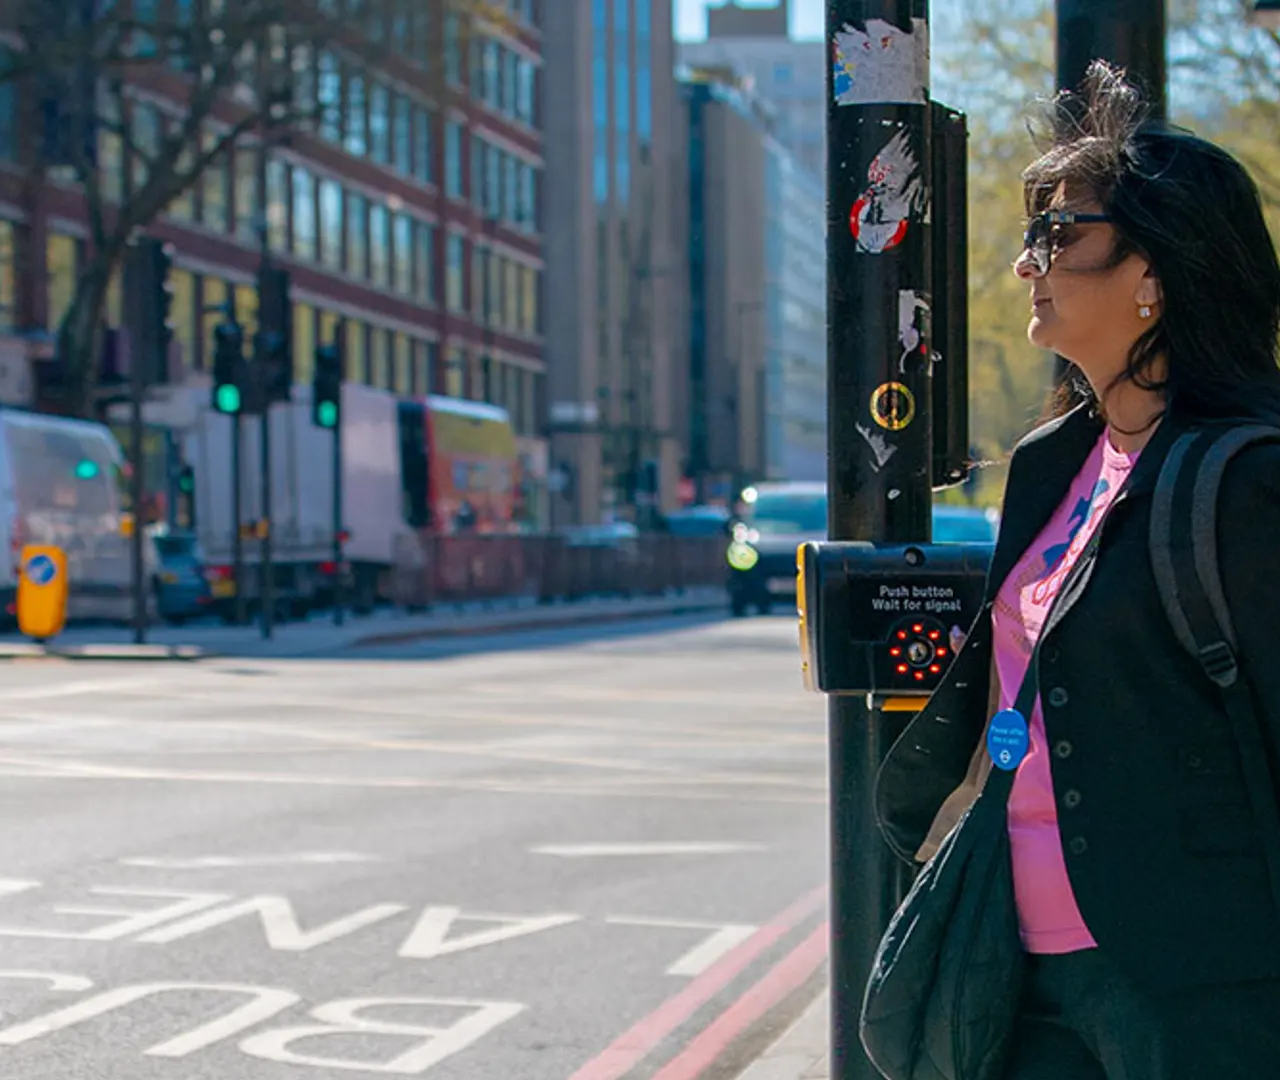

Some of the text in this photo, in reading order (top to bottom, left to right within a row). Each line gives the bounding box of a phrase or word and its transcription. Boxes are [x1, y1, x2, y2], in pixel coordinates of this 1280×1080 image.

[880, 585, 953, 597] Push button
[872, 599, 961, 612] Wait for signal
